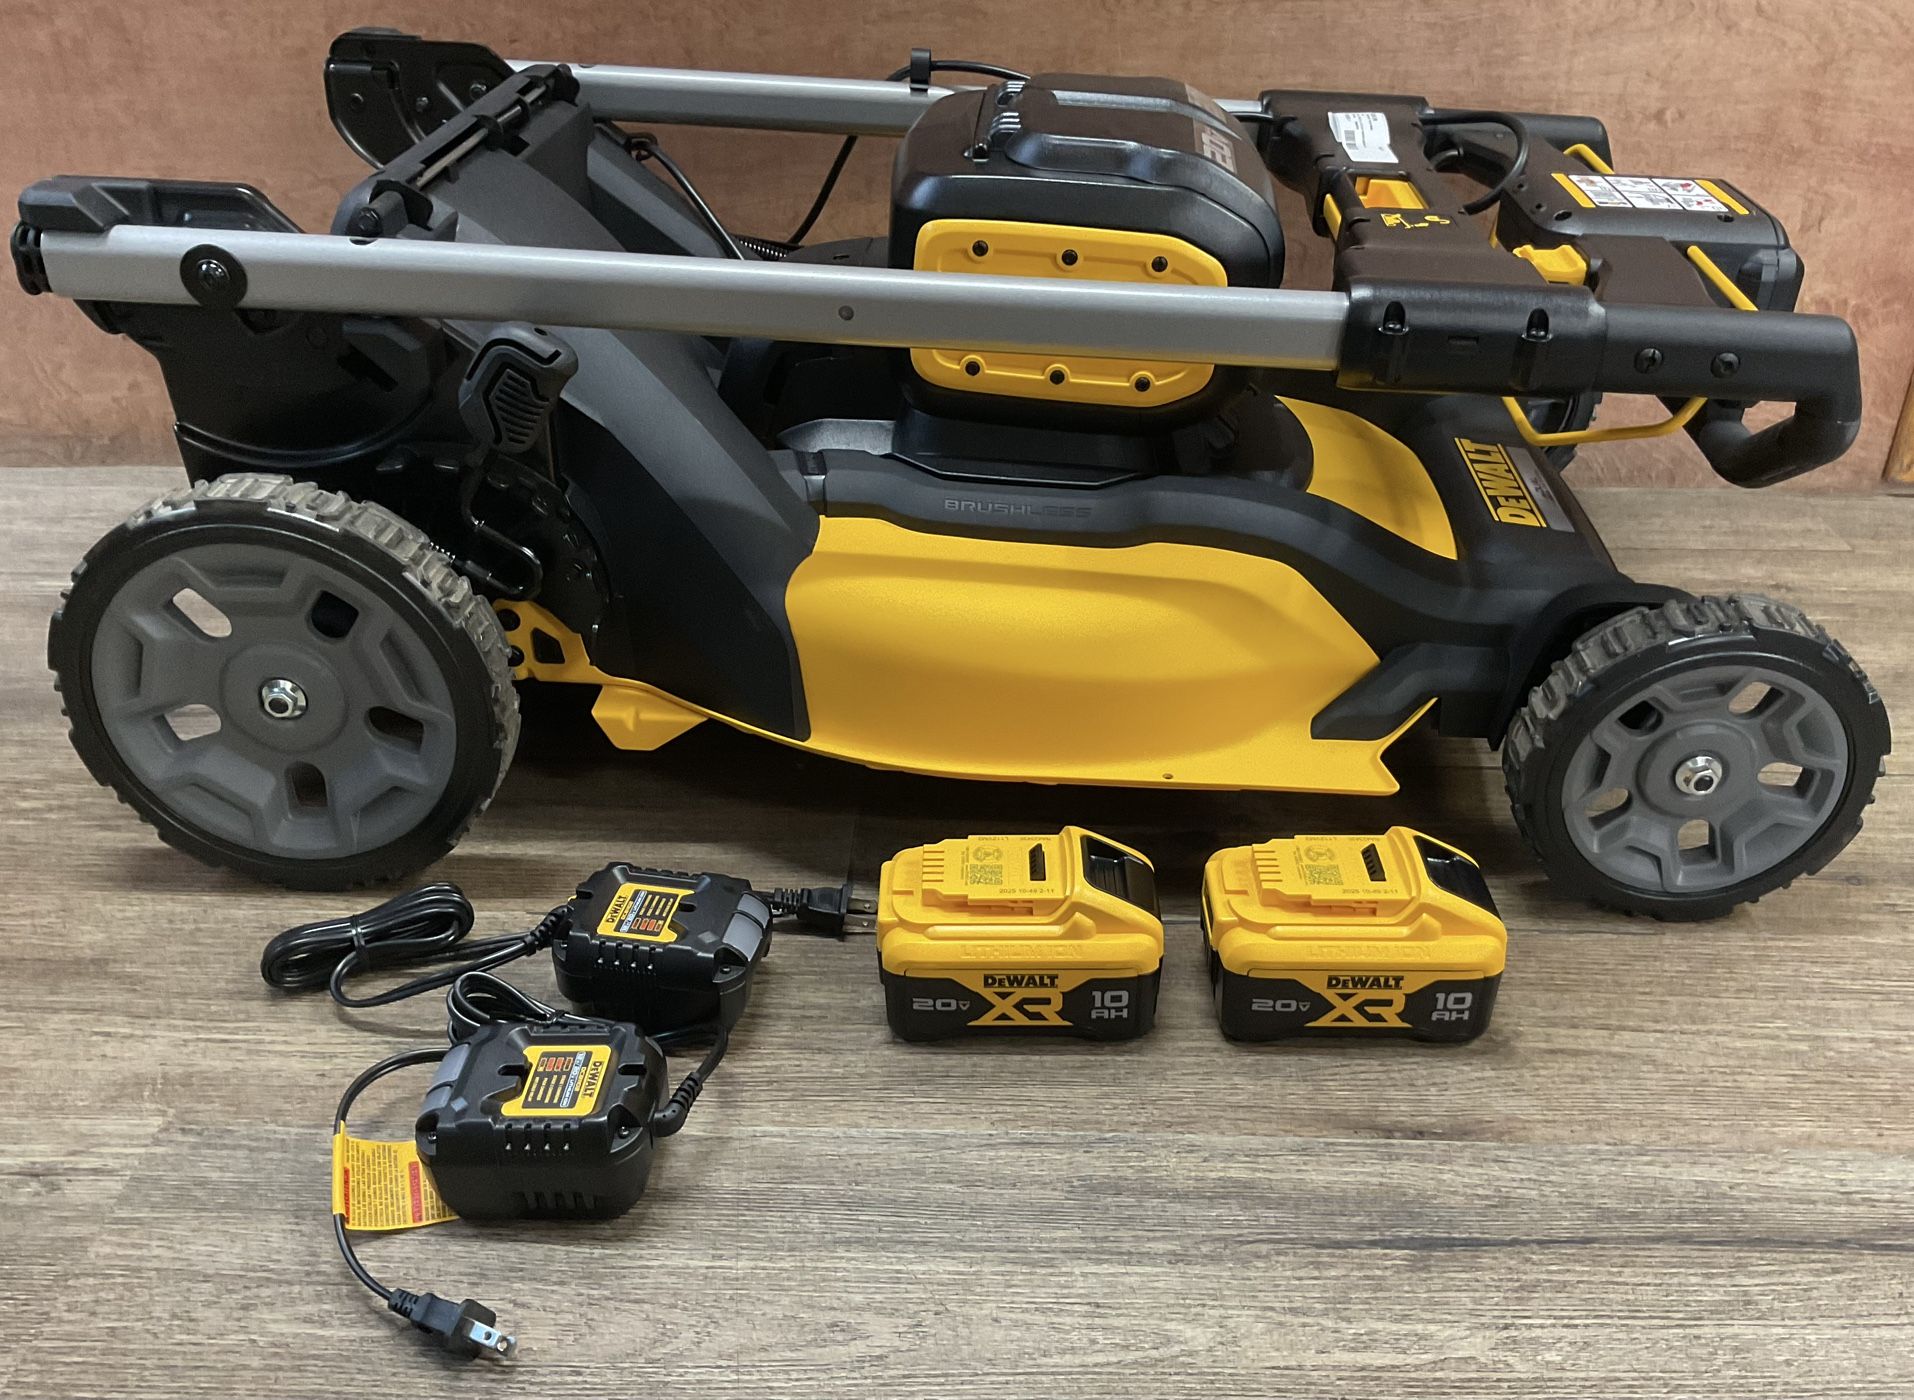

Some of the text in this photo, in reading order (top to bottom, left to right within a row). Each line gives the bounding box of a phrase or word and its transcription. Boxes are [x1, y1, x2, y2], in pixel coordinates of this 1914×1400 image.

[1459, 438, 1541, 527] DEWALT
[944, 498, 1093, 518] BRUSHLESS
[983, 974, 1059, 989] DEWALT
[1327, 975, 1405, 990] DEWALT
[1091, 990, 1129, 1008] 10
[1435, 992, 1473, 1010] 10
[967, 990, 1074, 1027] XR
[1090, 1008, 1128, 1019] AH
[1303, 991, 1413, 1028] XR
[1431, 1010, 1469, 1021] AH
[581, 1060, 603, 1098] DEWALT
